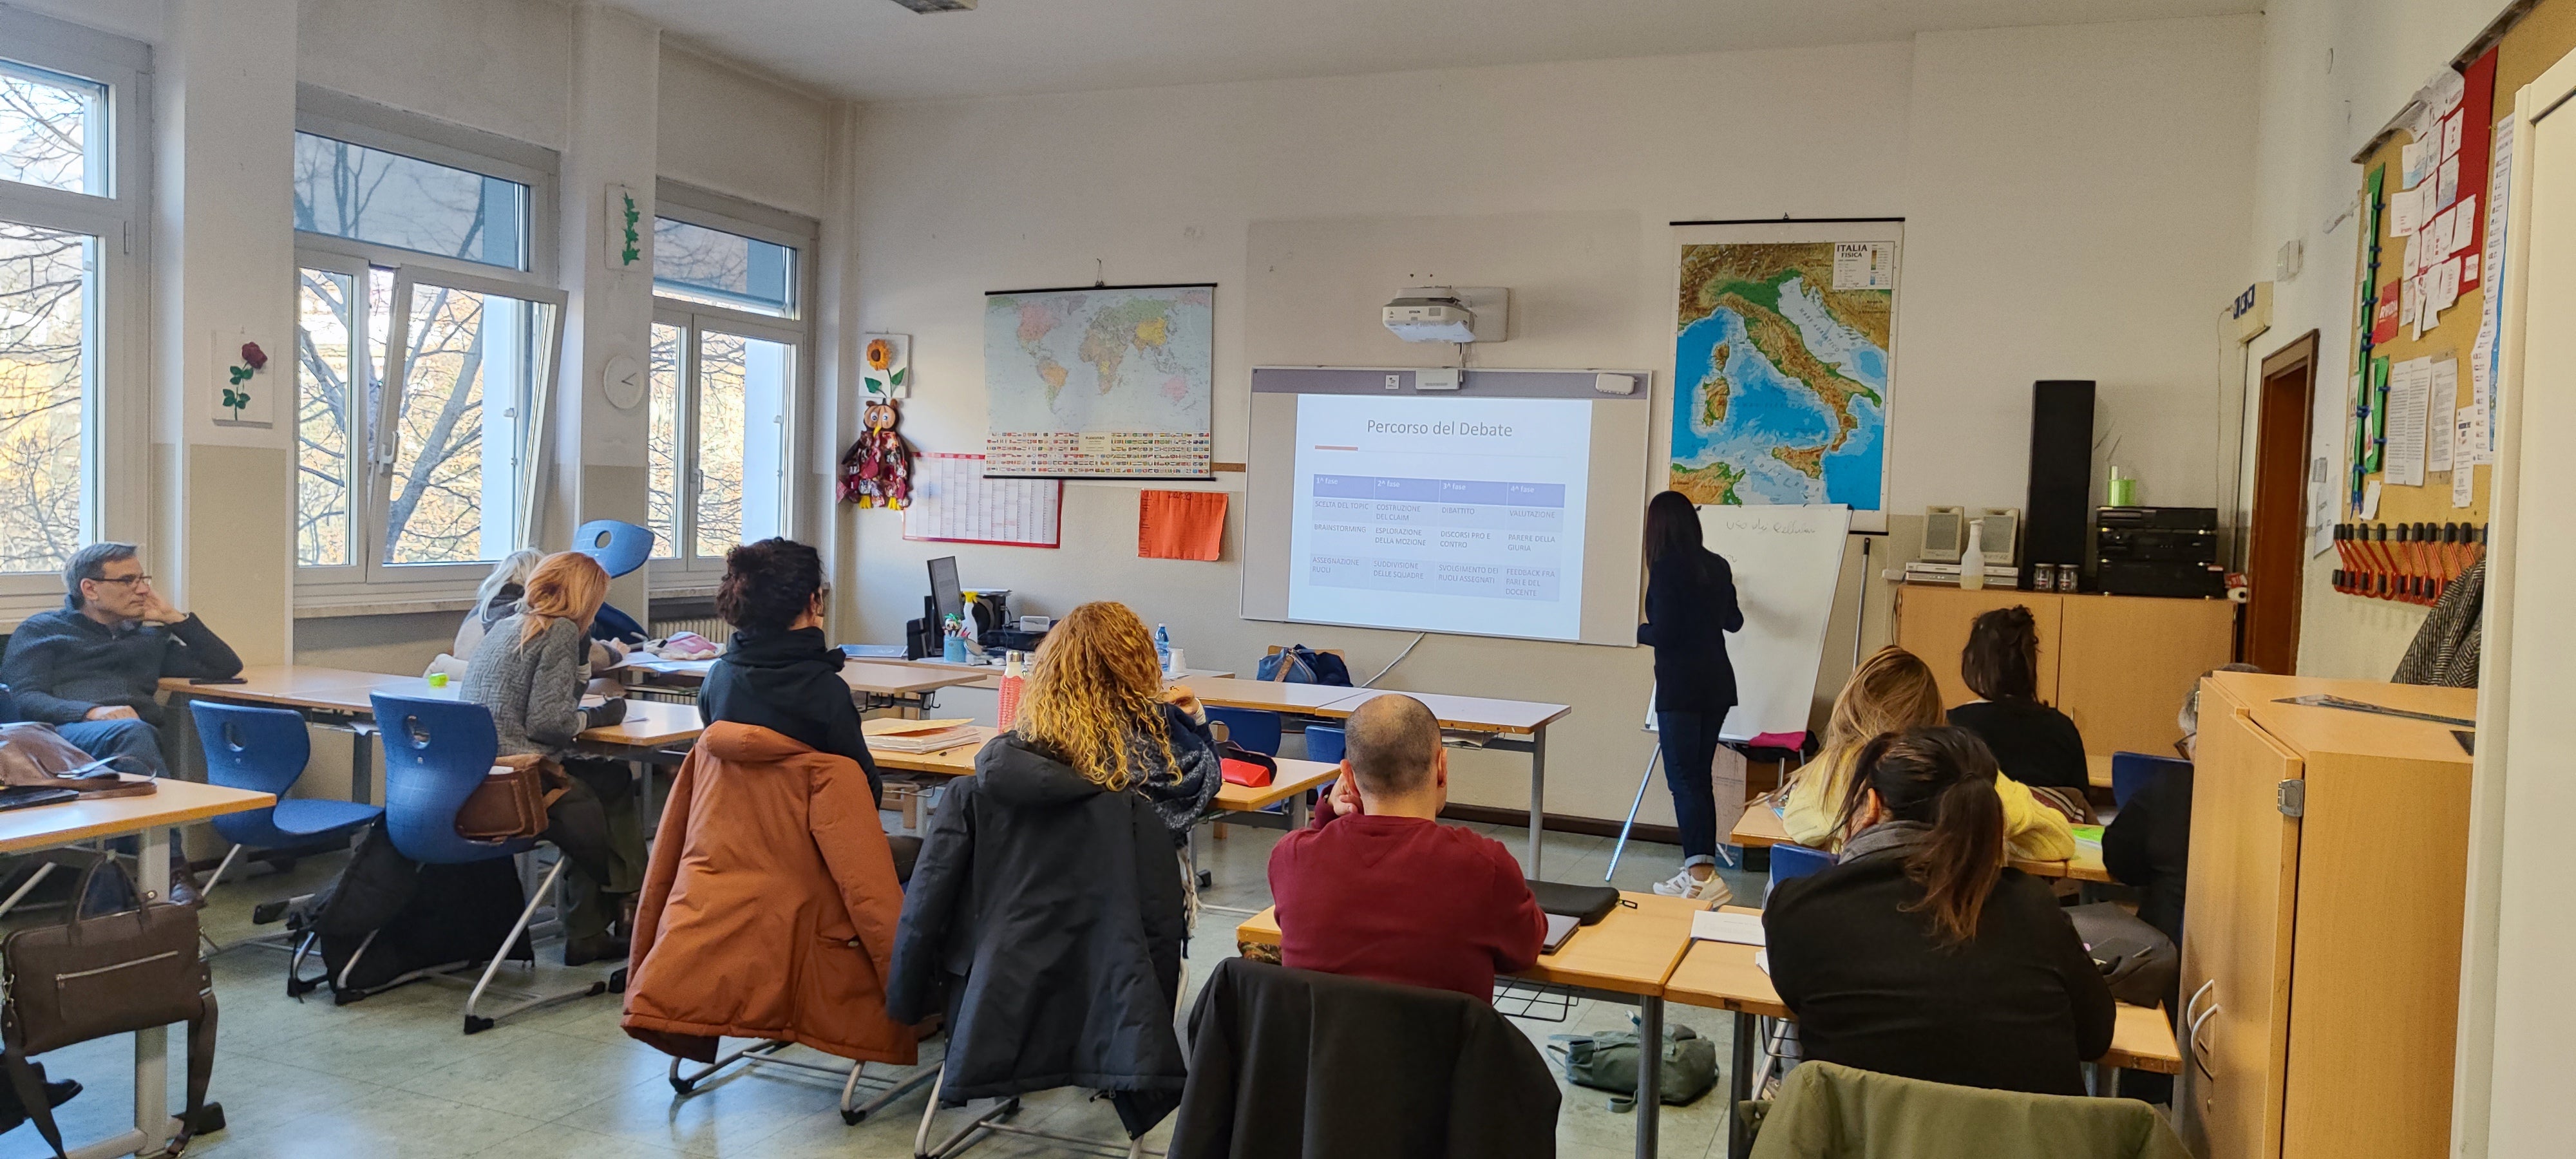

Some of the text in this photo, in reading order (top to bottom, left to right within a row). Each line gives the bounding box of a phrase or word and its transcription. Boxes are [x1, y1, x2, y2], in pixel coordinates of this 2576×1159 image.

[1367, 419, 1513, 437] Percorso del Debate
[1376, 504, 1421, 513] COSTRUZIONE
[1441, 507, 1475, 515] DIBATTITO
[1509, 510, 1555, 518] VALUTAZIONE
[1314, 523, 1367, 533] BRAINSTORMING
[1375, 527, 1423, 536] ESPLORAZIONE
[1441, 531, 1470, 539] DISCORSI
[1508, 534, 1533, 542] PARERE
[1440, 540, 1468, 549] CONTRO
[1312, 556, 1359, 566] ASSEGNAZIONE
[1374, 560, 1419, 569] SUDDIVISIONE
[1438, 564, 1486, 574] SVOLGIMENTO
[1506, 569, 1540, 577] FEEDBACK
[1393, 571, 1424, 580] SQUADRE
[1438, 574, 1495, 584] RUOLI ASSEGNATI
[1505, 589, 1537, 597] DOCENTE
